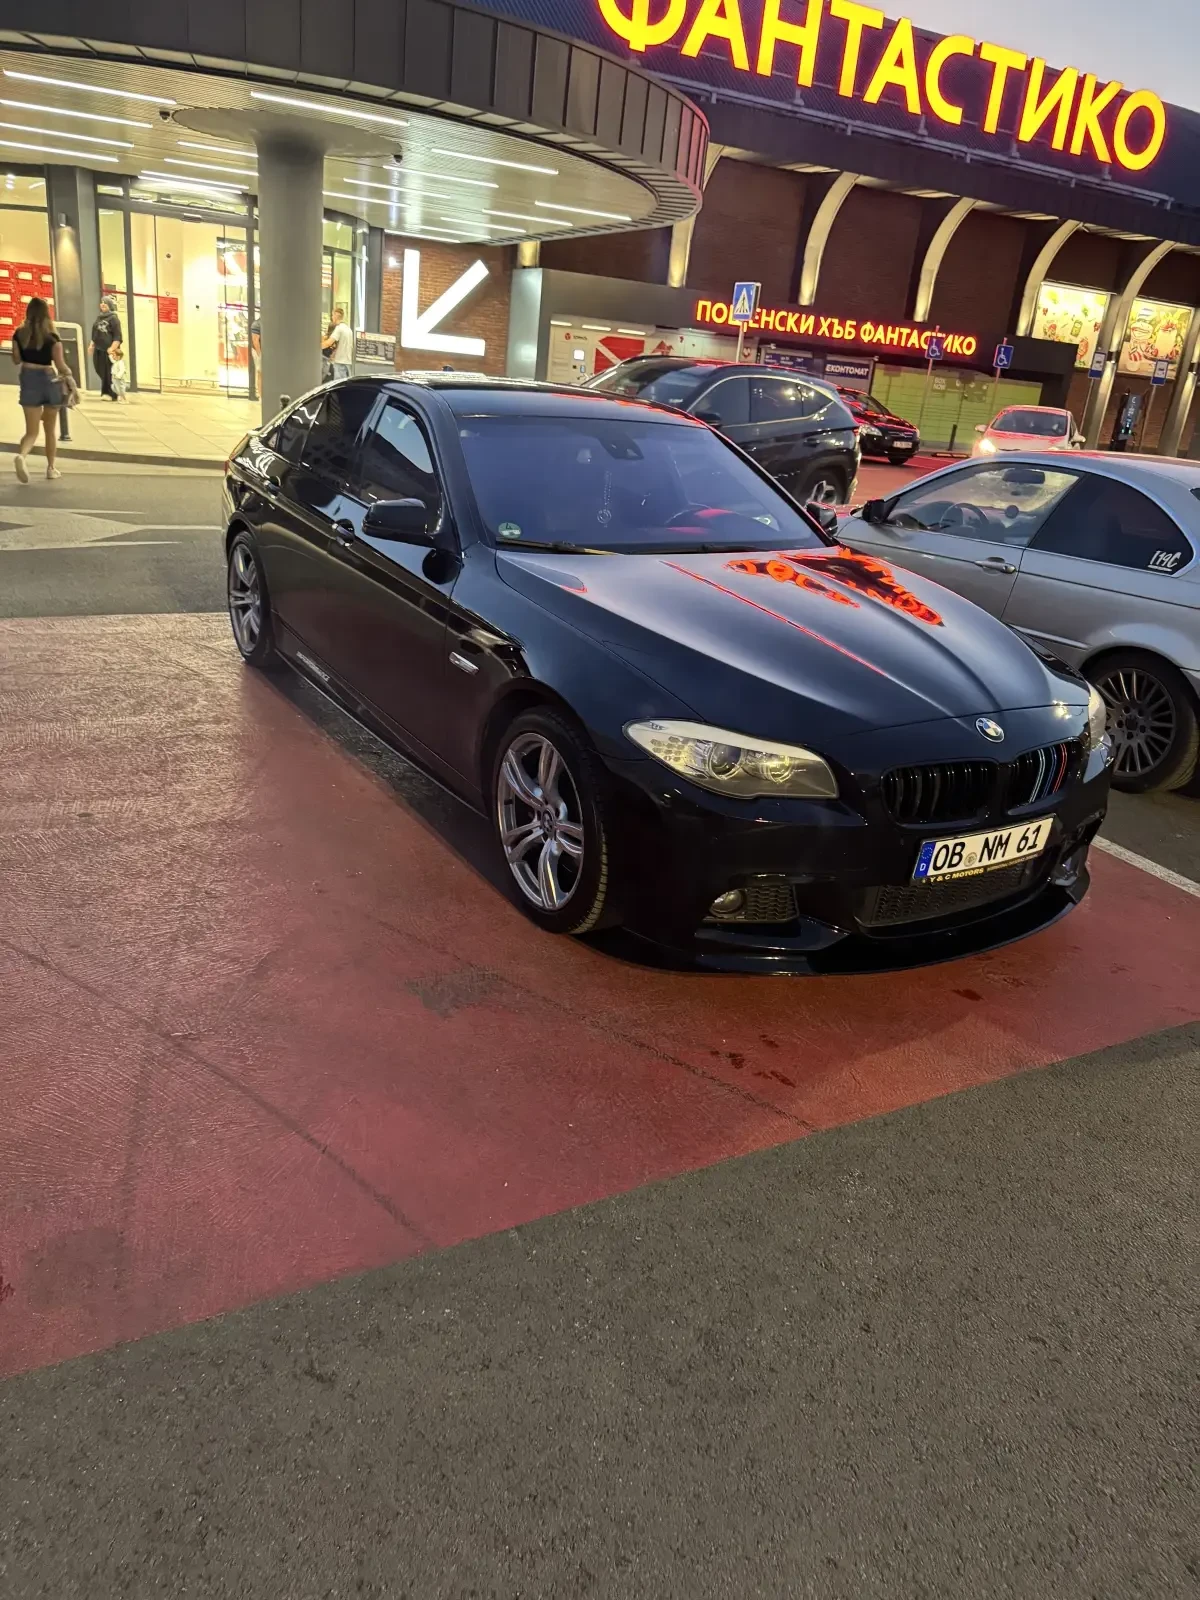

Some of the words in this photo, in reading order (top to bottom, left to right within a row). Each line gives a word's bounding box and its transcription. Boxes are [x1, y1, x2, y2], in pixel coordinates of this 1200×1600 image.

[817, 316, 857, 340] ХЪБ
[932, 841, 966, 871] OB
[978, 832, 1012, 863] NM
[1016, 824, 1042, 853] 61
[919, 862, 926, 871] D
[951, 867, 985, 879] MOTORS
